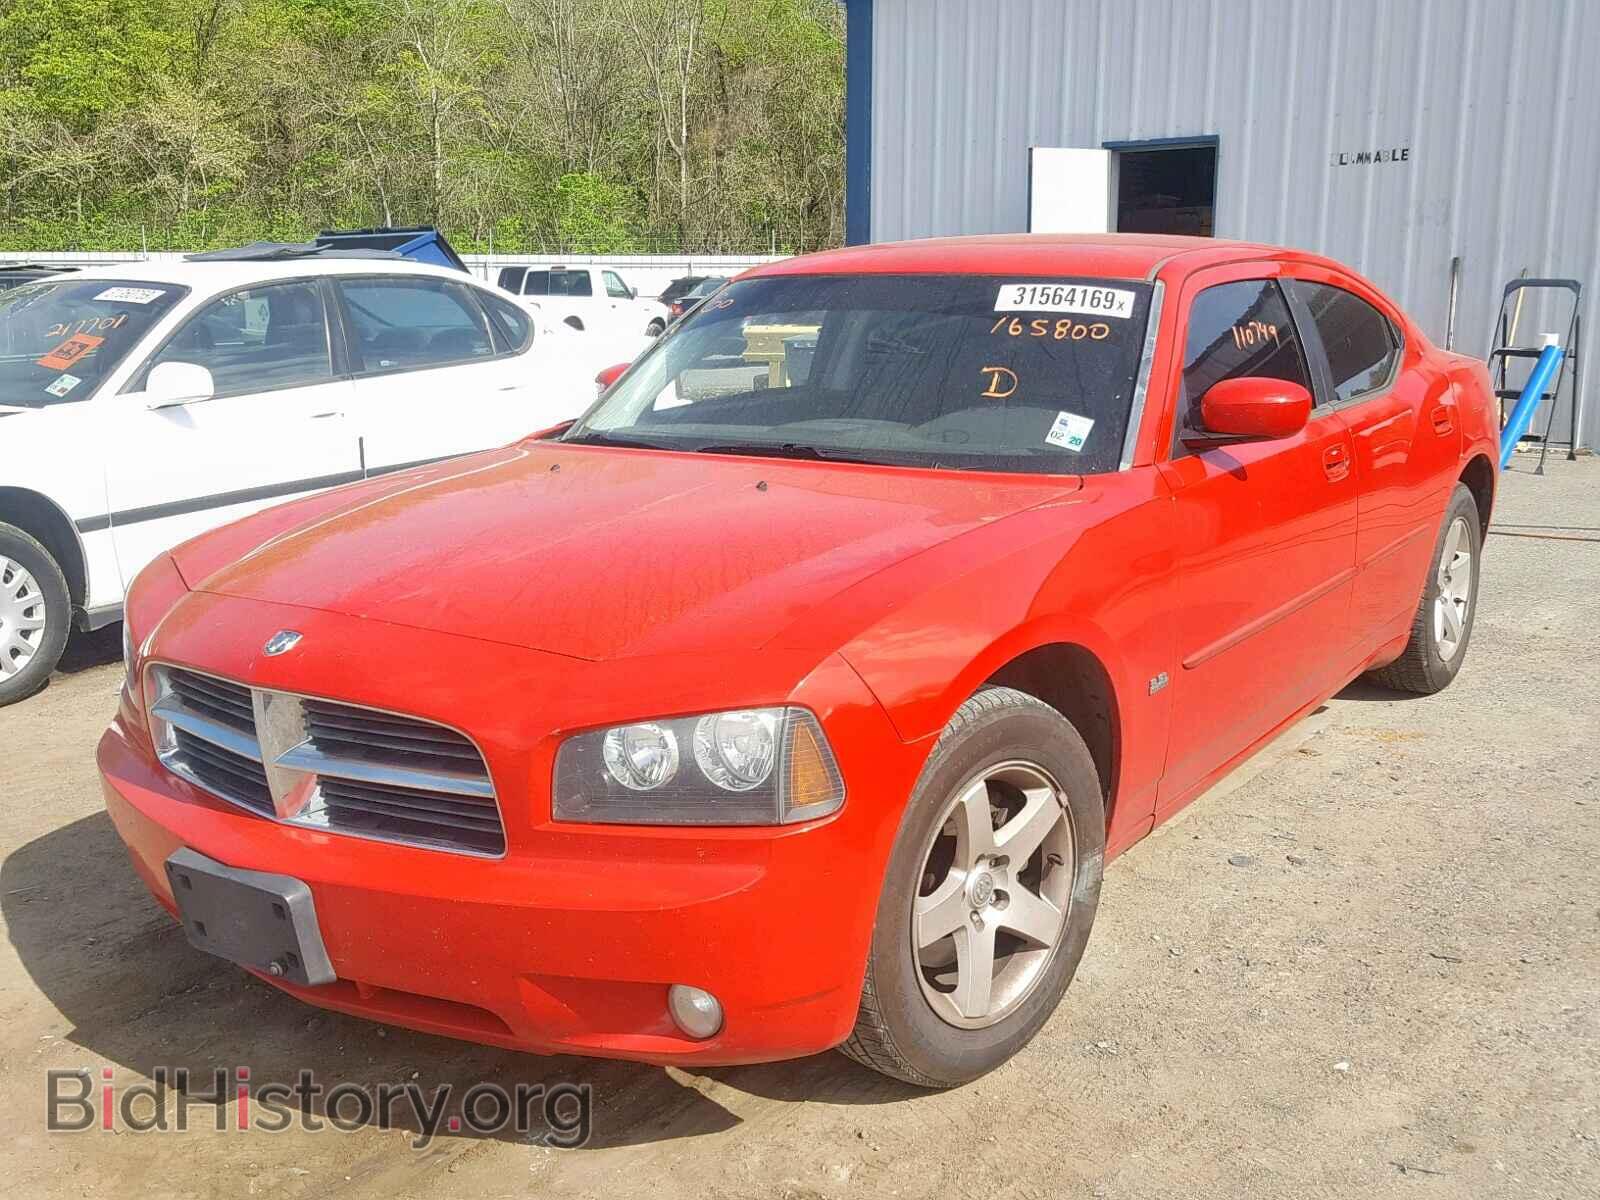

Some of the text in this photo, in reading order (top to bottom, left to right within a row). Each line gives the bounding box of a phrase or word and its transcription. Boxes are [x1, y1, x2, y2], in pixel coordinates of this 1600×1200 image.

[990, 315, 1111, 340] 165800
[1231, 317, 1281, 351] 110749
[980, 366, 1019, 398] D
[1050, 430, 1065, 441] 02
